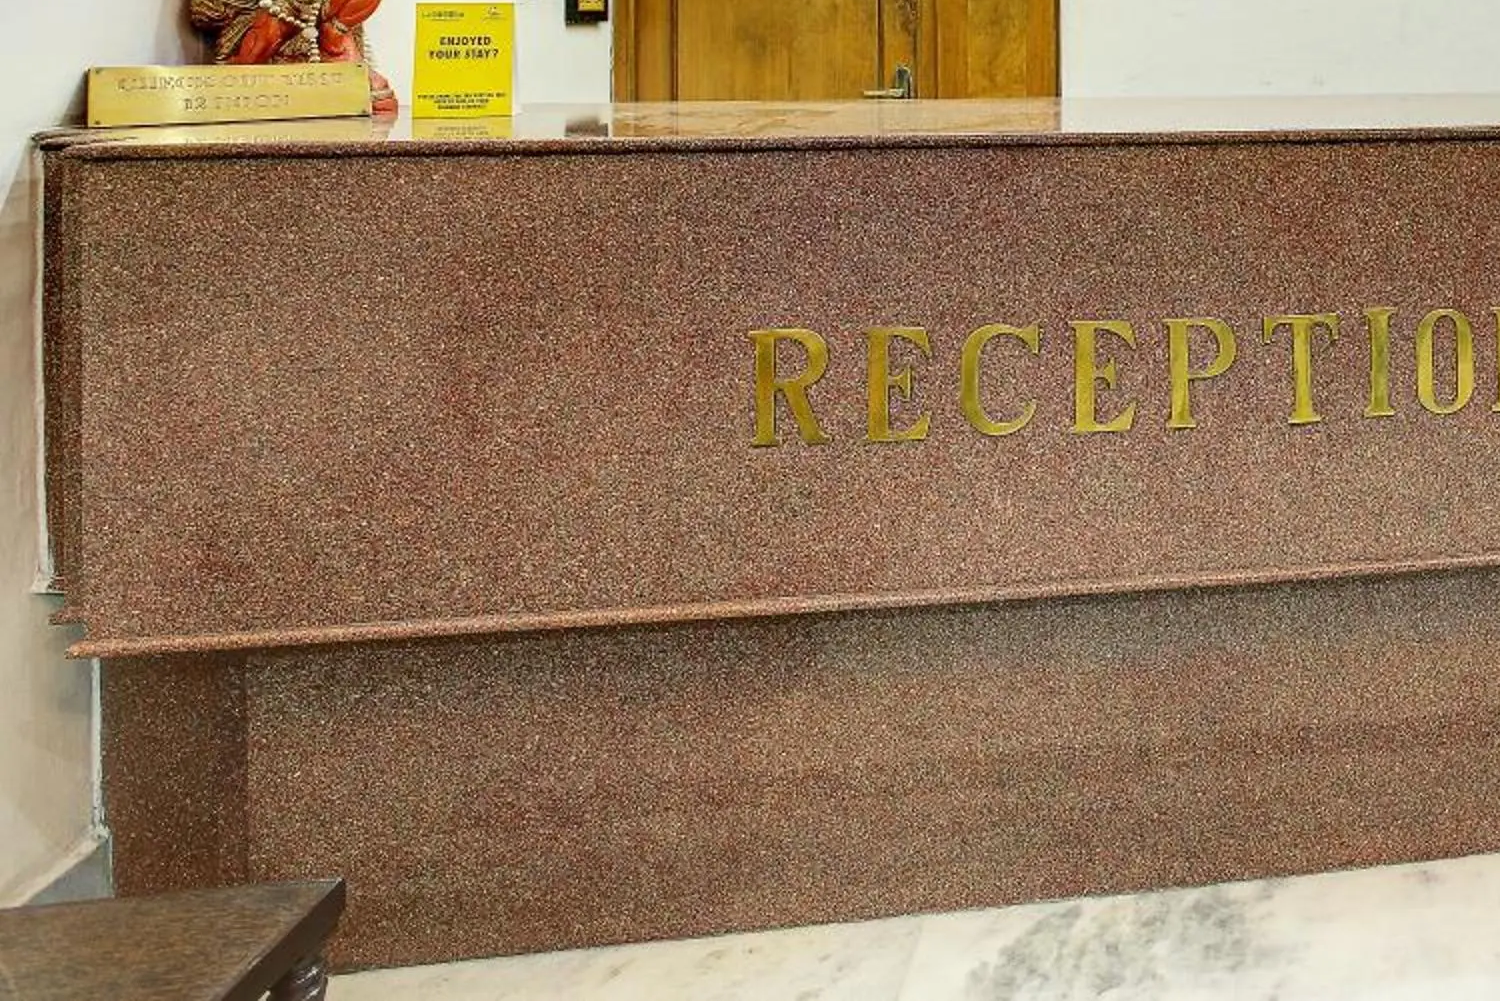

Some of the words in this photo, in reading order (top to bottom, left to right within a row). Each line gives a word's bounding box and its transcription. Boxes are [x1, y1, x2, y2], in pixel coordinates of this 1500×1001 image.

[439, 36, 492, 46] ENJOYED
[429, 49, 461, 60] YOUR
[465, 48, 500, 59] STAY?
